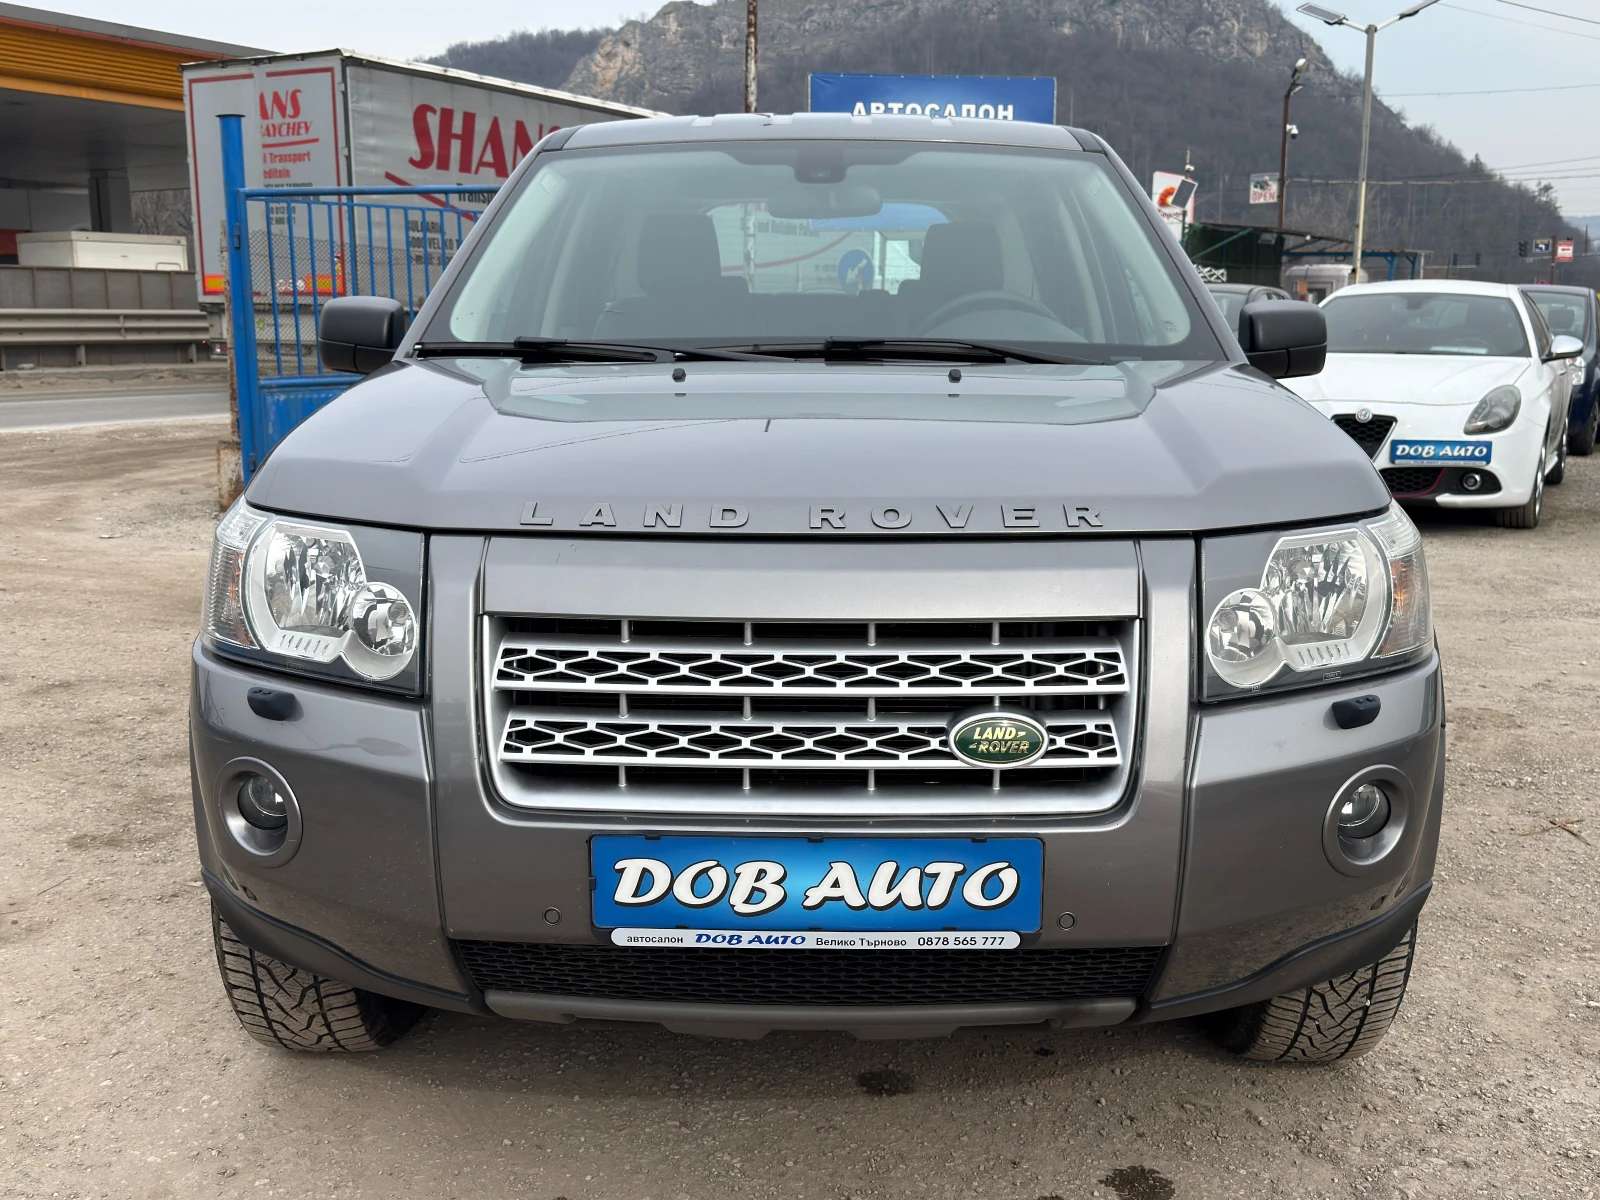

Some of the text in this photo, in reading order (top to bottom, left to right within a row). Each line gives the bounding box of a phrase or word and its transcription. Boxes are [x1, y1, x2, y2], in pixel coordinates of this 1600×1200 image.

[260, 121, 313, 138] AYCHEV
[408, 103, 562, 179] SHAN
[269, 151, 311, 165] Transport
[1251, 191, 1275, 202] OPEN
[1396, 445, 1487, 458] DOB AUTO
[519, 501, 1104, 530] LAND ROVER
[973, 727, 1017, 740] LAND
[978, 741, 1030, 753] ROVER
[613, 857, 1021, 917] DOB AUTO
[626, 933, 1006, 948] автосалон DOB AUTO Велико Търново 0878 565 777
